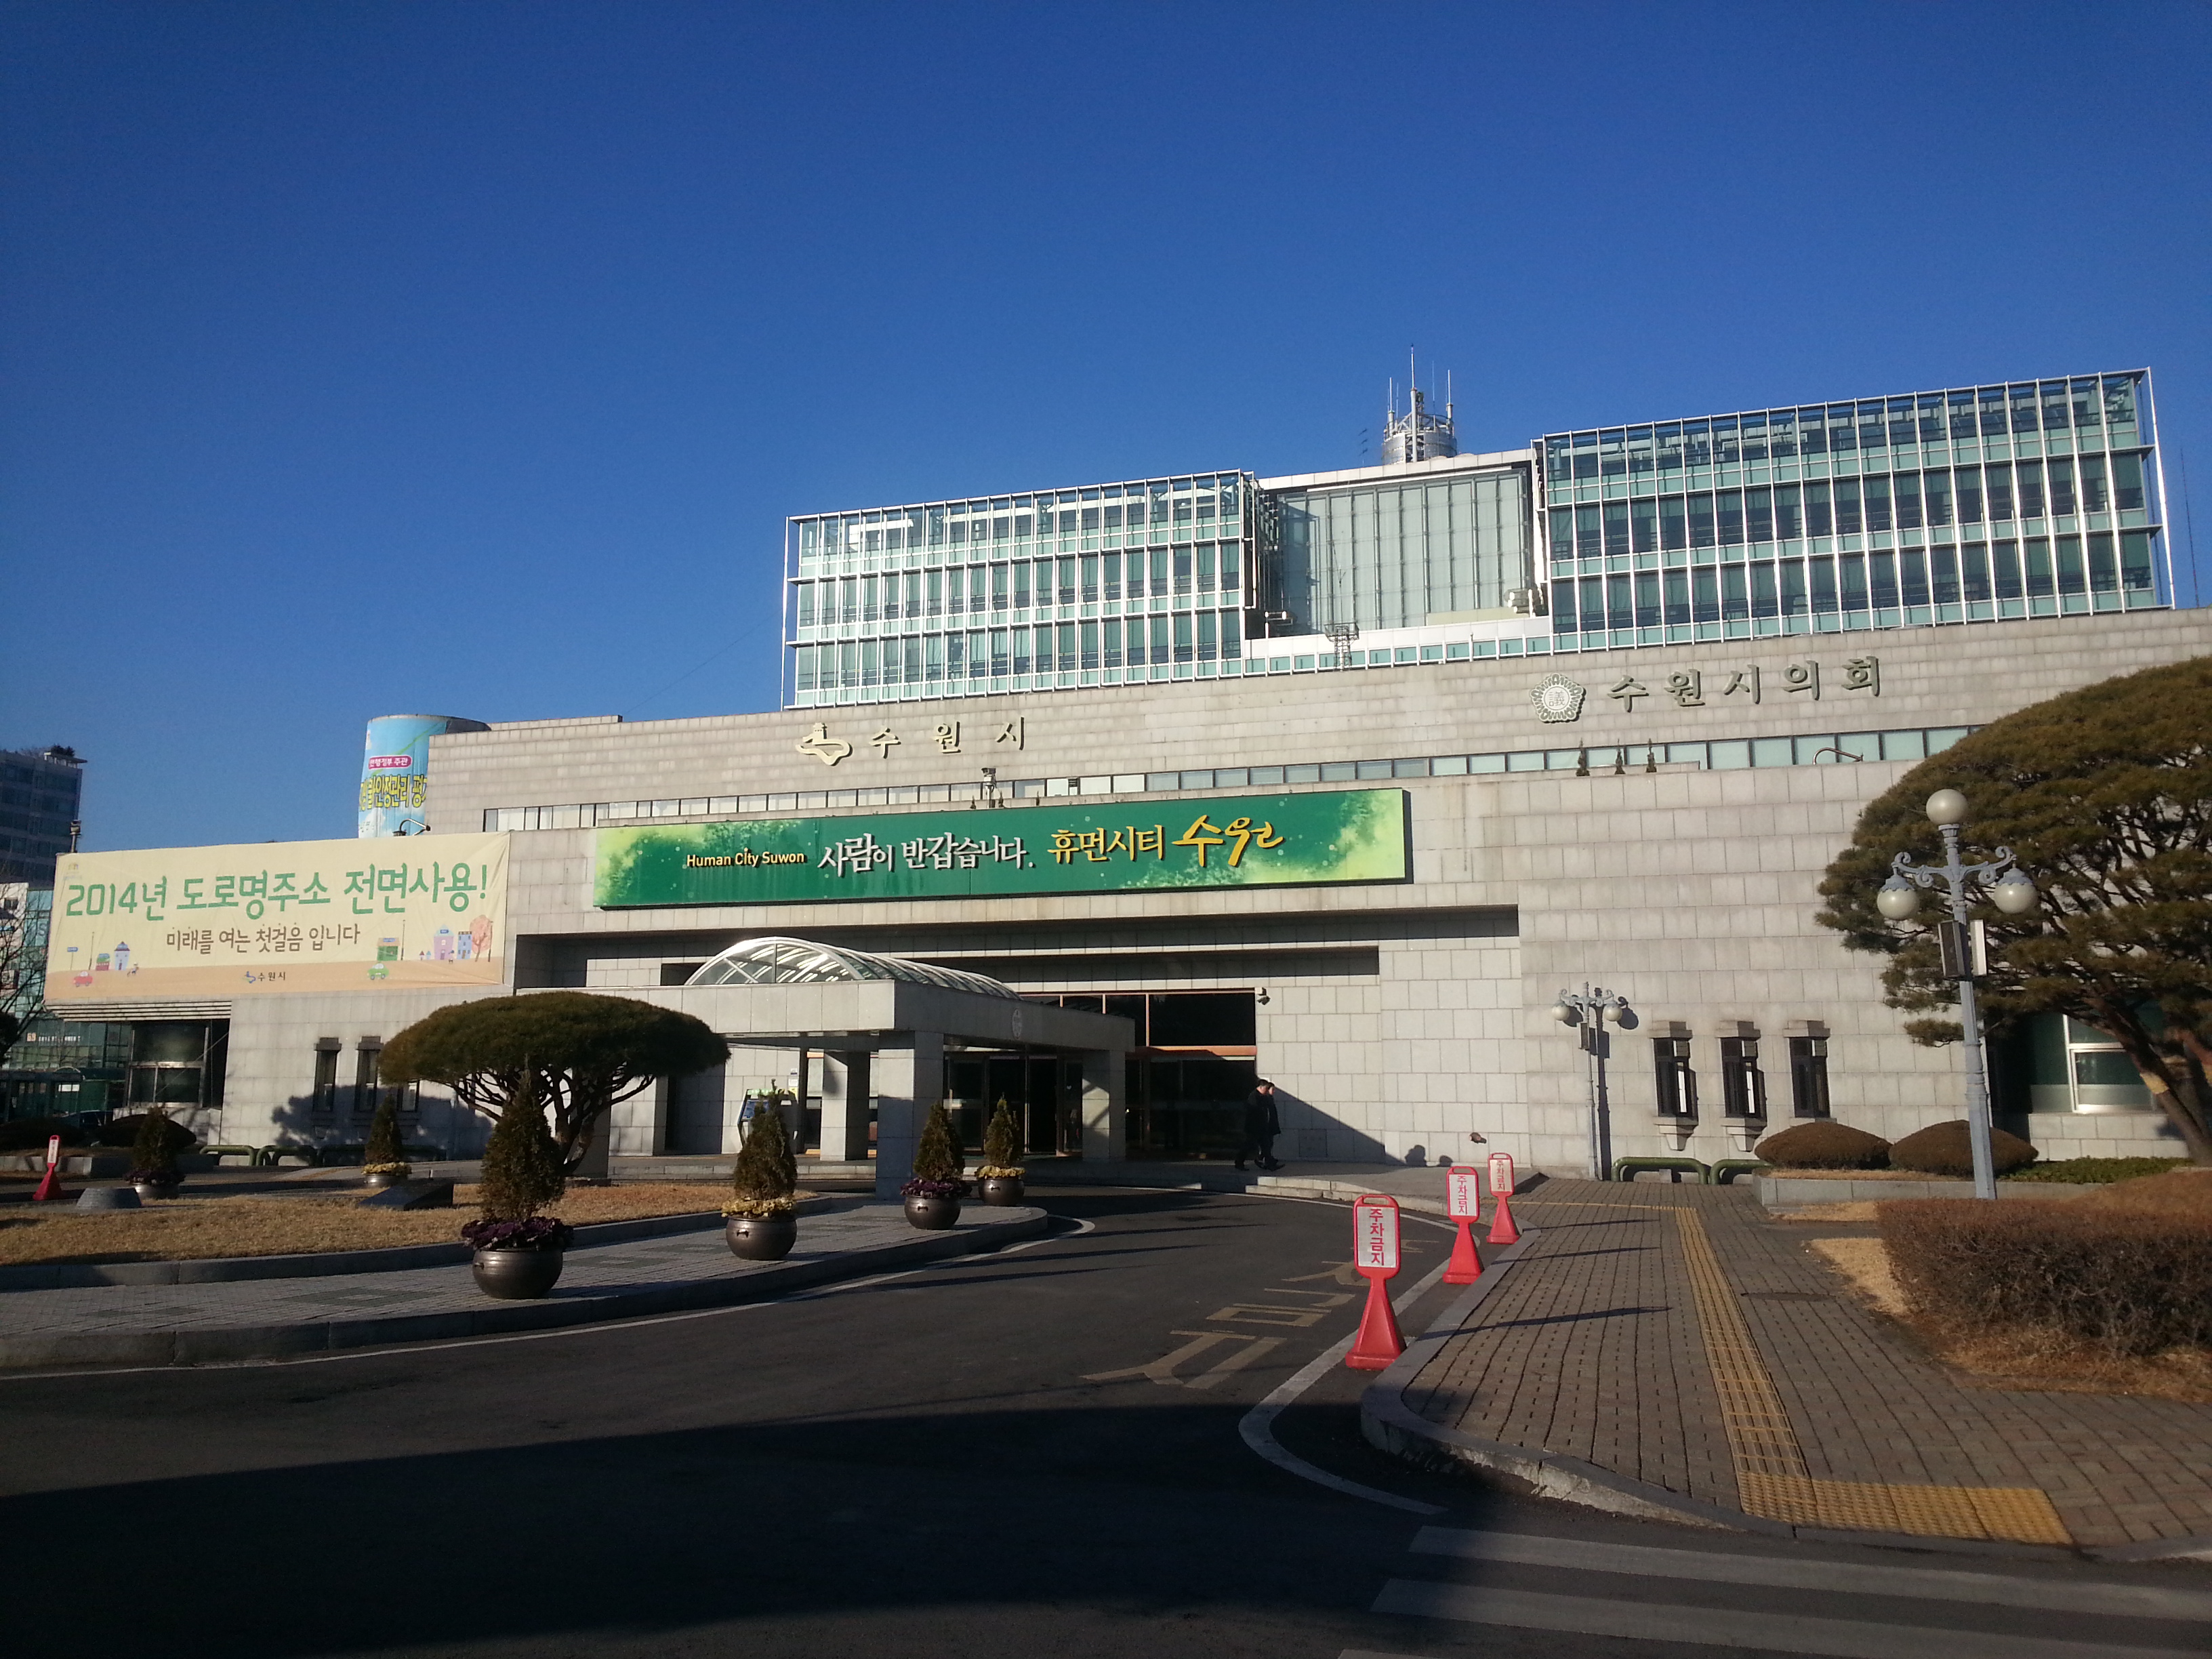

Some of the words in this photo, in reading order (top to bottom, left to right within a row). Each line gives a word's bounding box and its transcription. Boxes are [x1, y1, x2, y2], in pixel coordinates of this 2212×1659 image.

[1607, 655, 1881, 713] 수원시의회
[869, 716, 1025, 759] 수원시
[686, 854, 731, 867] Human
[735, 848, 758, 867] City
[762, 851, 805, 865] Suwon
[817, 833, 893, 877] 사람이
[901, 832, 1035, 870] 반갑습니다.
[1047, 825, 1164, 864] 휴먼시티
[1171, 814, 1285, 867] 수원
[66, 876, 167, 921] 2014년
[177, 869, 331, 920] 도로명주소
[344, 861, 487, 914] 전면사용!
[167, 926, 213, 954] 미래를
[219, 927, 250, 953] 여는
[255, 925, 303, 953] 첫걸음
[309, 924, 360, 951] 입니다
[258, 972, 286, 982] 수원시
[1457, 1175, 1467, 1215] 주차금지
[1496, 1160, 1505, 1191] 주차금지
[1370, 1208, 1385, 1265] 주차금지
